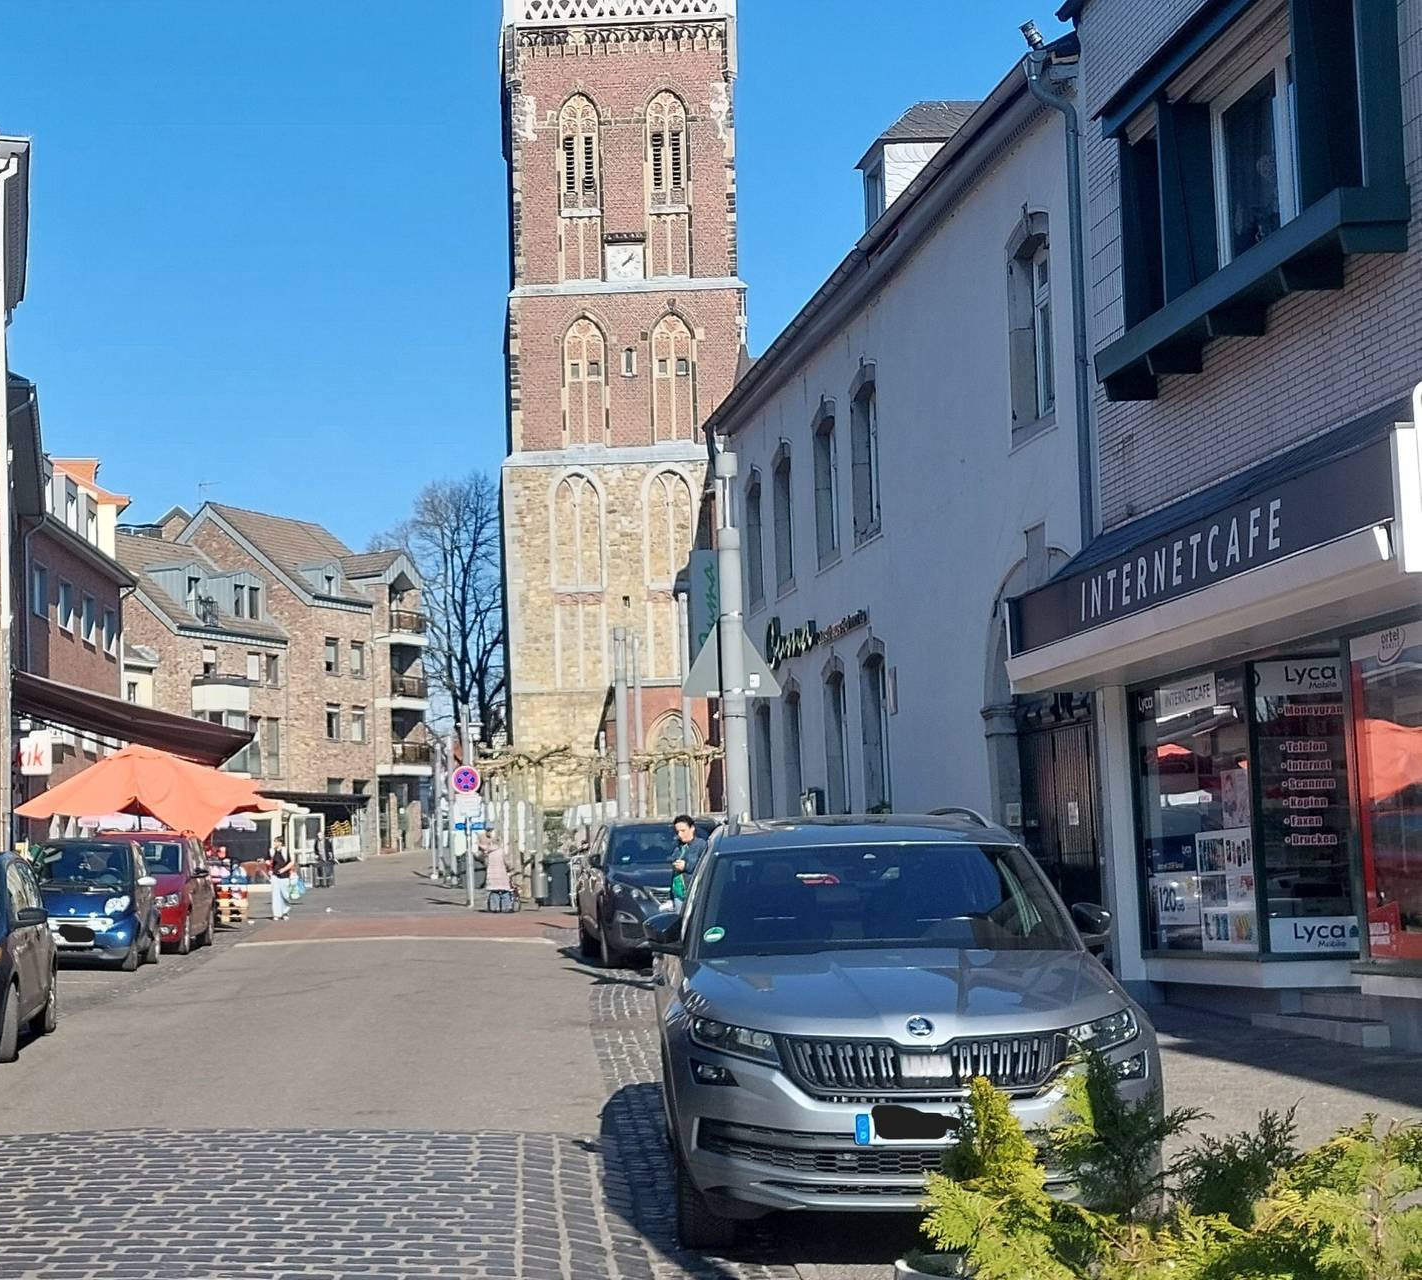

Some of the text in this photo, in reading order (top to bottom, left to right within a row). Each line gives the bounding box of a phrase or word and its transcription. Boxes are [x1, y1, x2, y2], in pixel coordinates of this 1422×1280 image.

[1081, 499, 1281, 621] INTERNETCAFE
[1285, 665, 1337, 685] Lyca
[1286, 741, 1328, 753] Telefon
[1287, 760, 1332, 771] Internet
[1288, 778, 1336, 790] Scannen
[1289, 797, 1328, 809] Kopien
[1292, 834, 1337, 846] Drucken
[1293, 922, 1346, 943] Lyca
